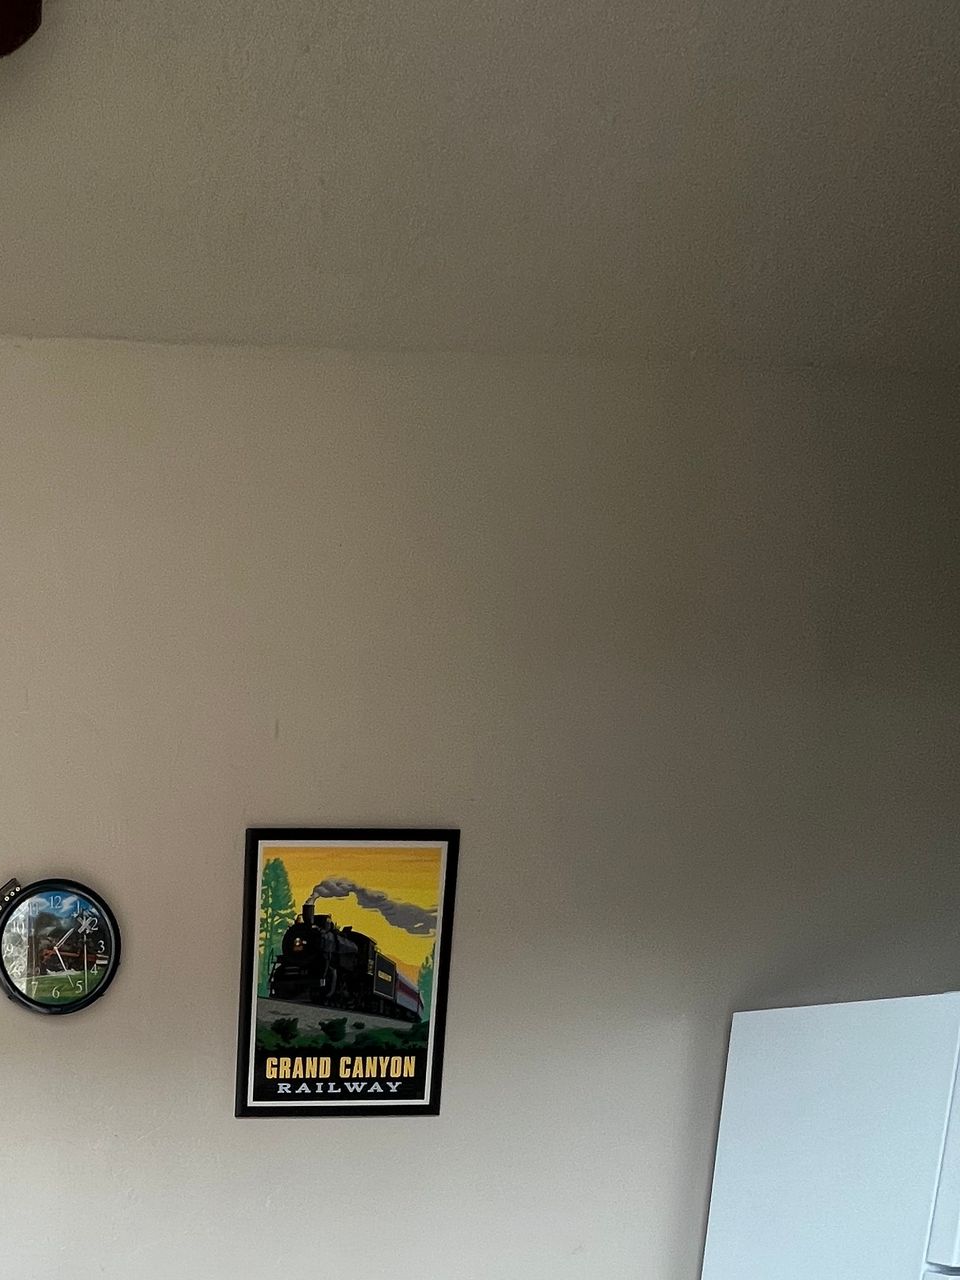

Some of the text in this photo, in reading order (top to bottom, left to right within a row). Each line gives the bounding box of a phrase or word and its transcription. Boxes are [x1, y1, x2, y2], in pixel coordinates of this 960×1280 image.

[48, 895, 62, 909] 12
[89, 918, 99, 931] 2
[97, 940, 106, 953] 3
[90, 963, 99, 975] 4
[51, 985, 60, 999] 6
[75, 981, 83, 994] 5
[265, 1055, 416, 1079] GRAND CANYON
[277, 1081, 402, 1093] RAILWAY
